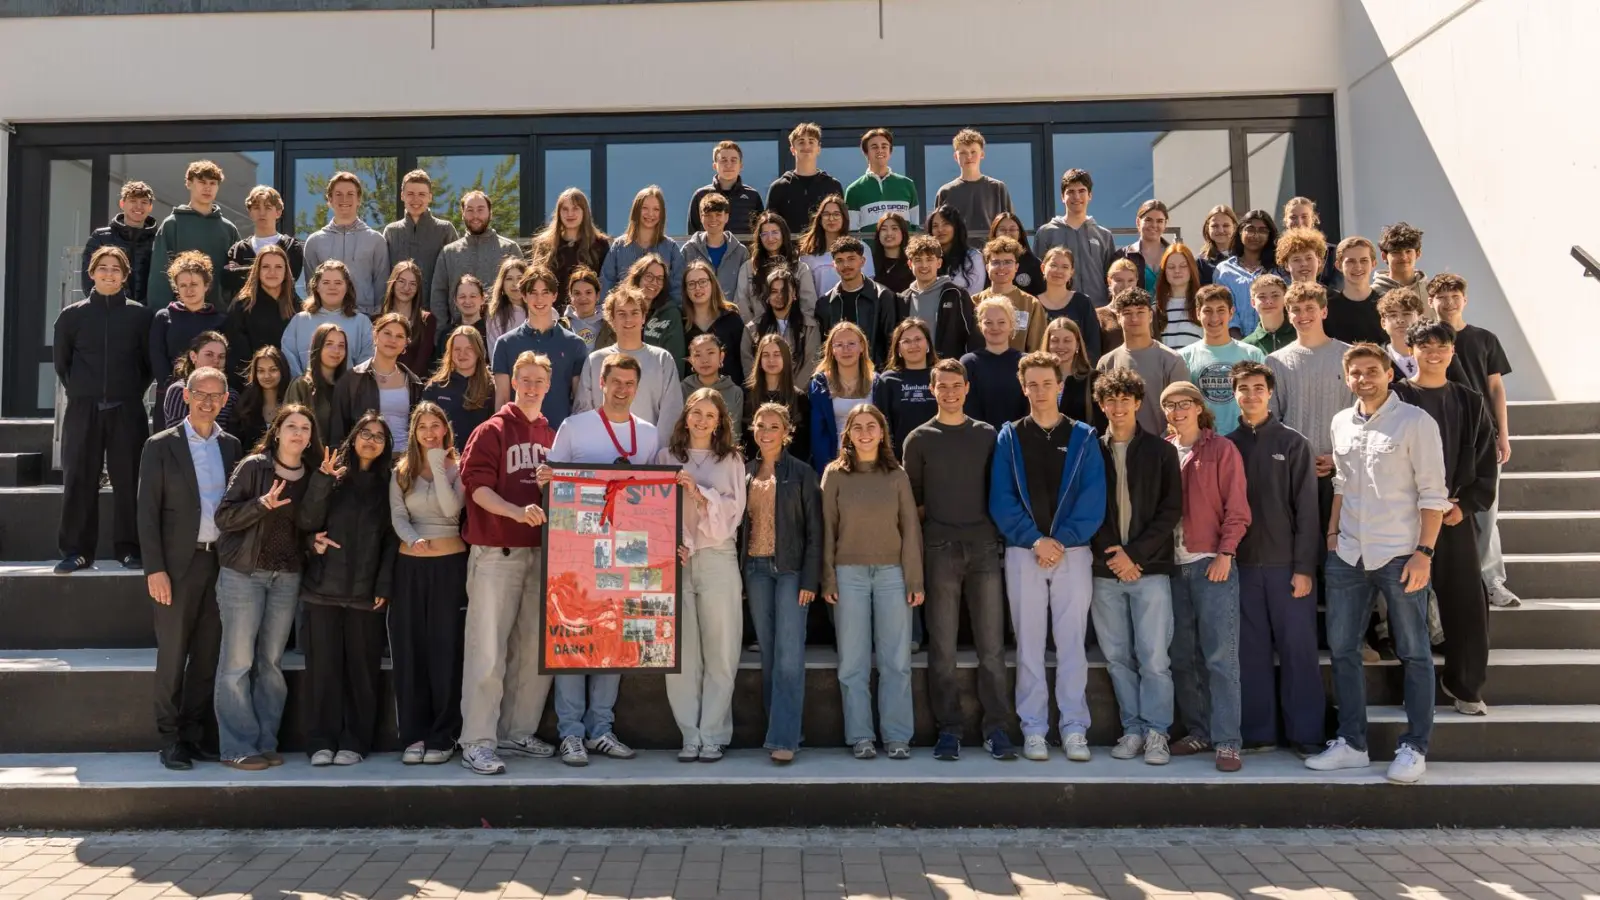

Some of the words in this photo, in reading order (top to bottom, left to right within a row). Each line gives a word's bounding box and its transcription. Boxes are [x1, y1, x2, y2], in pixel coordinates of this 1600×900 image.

[868, 205, 886, 213] POLO
[626, 484, 673, 505] SMV
[549, 624, 593, 637] VIELEN
